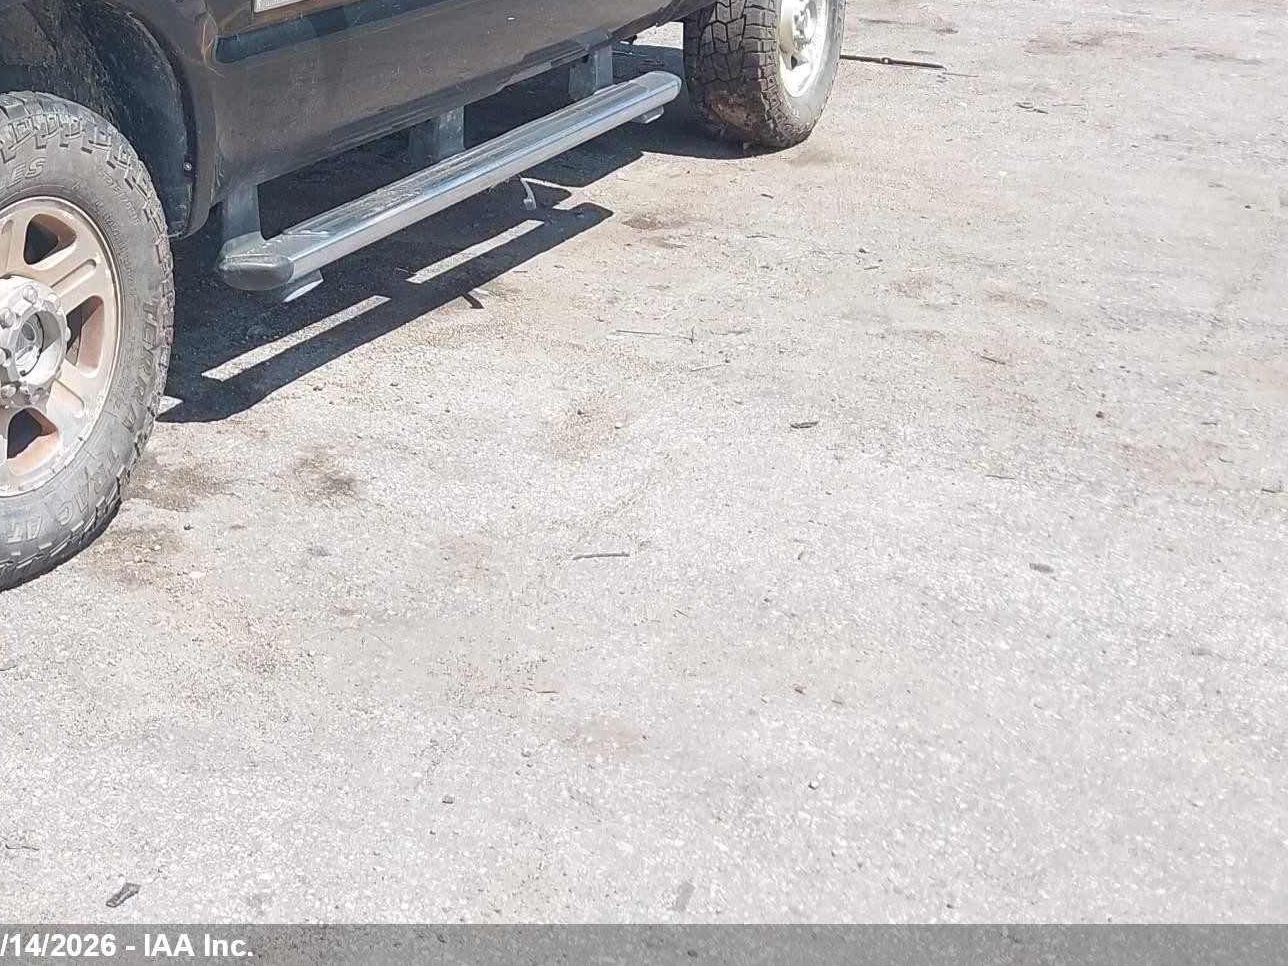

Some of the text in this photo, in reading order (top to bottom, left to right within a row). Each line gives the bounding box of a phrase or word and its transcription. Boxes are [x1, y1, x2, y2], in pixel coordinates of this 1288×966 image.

[122, 298, 159, 434] TERRA
[56, 449, 122, 527] TRAC
[7, 516, 44, 544] AT
